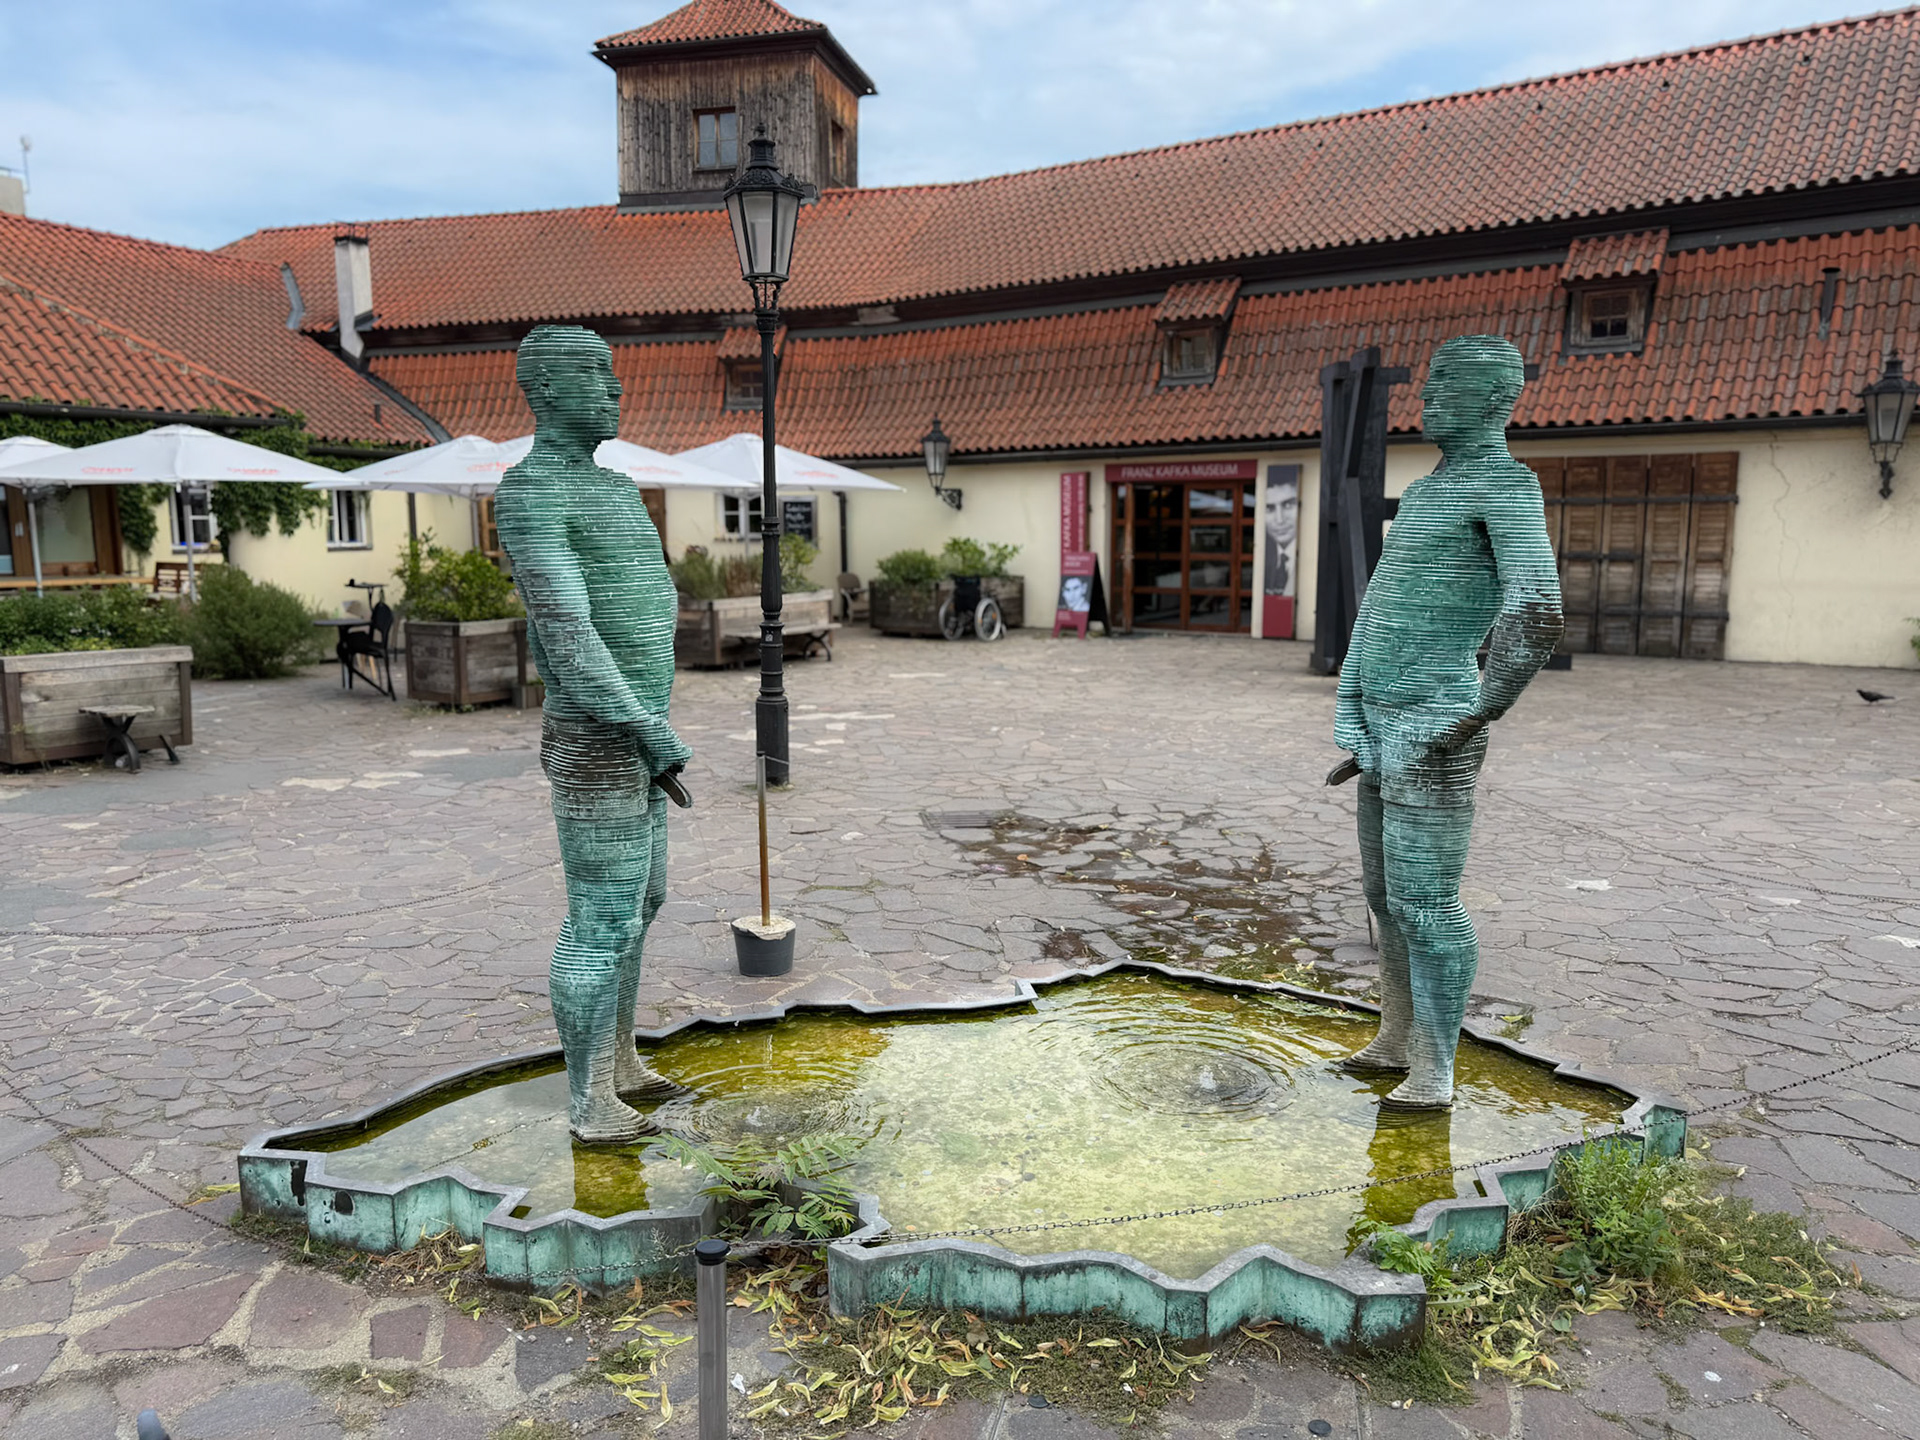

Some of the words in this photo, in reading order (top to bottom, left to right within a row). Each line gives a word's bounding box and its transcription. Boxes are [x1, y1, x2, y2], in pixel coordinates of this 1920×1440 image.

[1121, 466, 1152, 478] FRANZ
[1155, 465, 1189, 477] KAFKA
[1192, 463, 1238, 476] MUSEUM
[1063, 475, 1072, 514] MUSEUM
[1063, 515, 1071, 548] KAFKA
